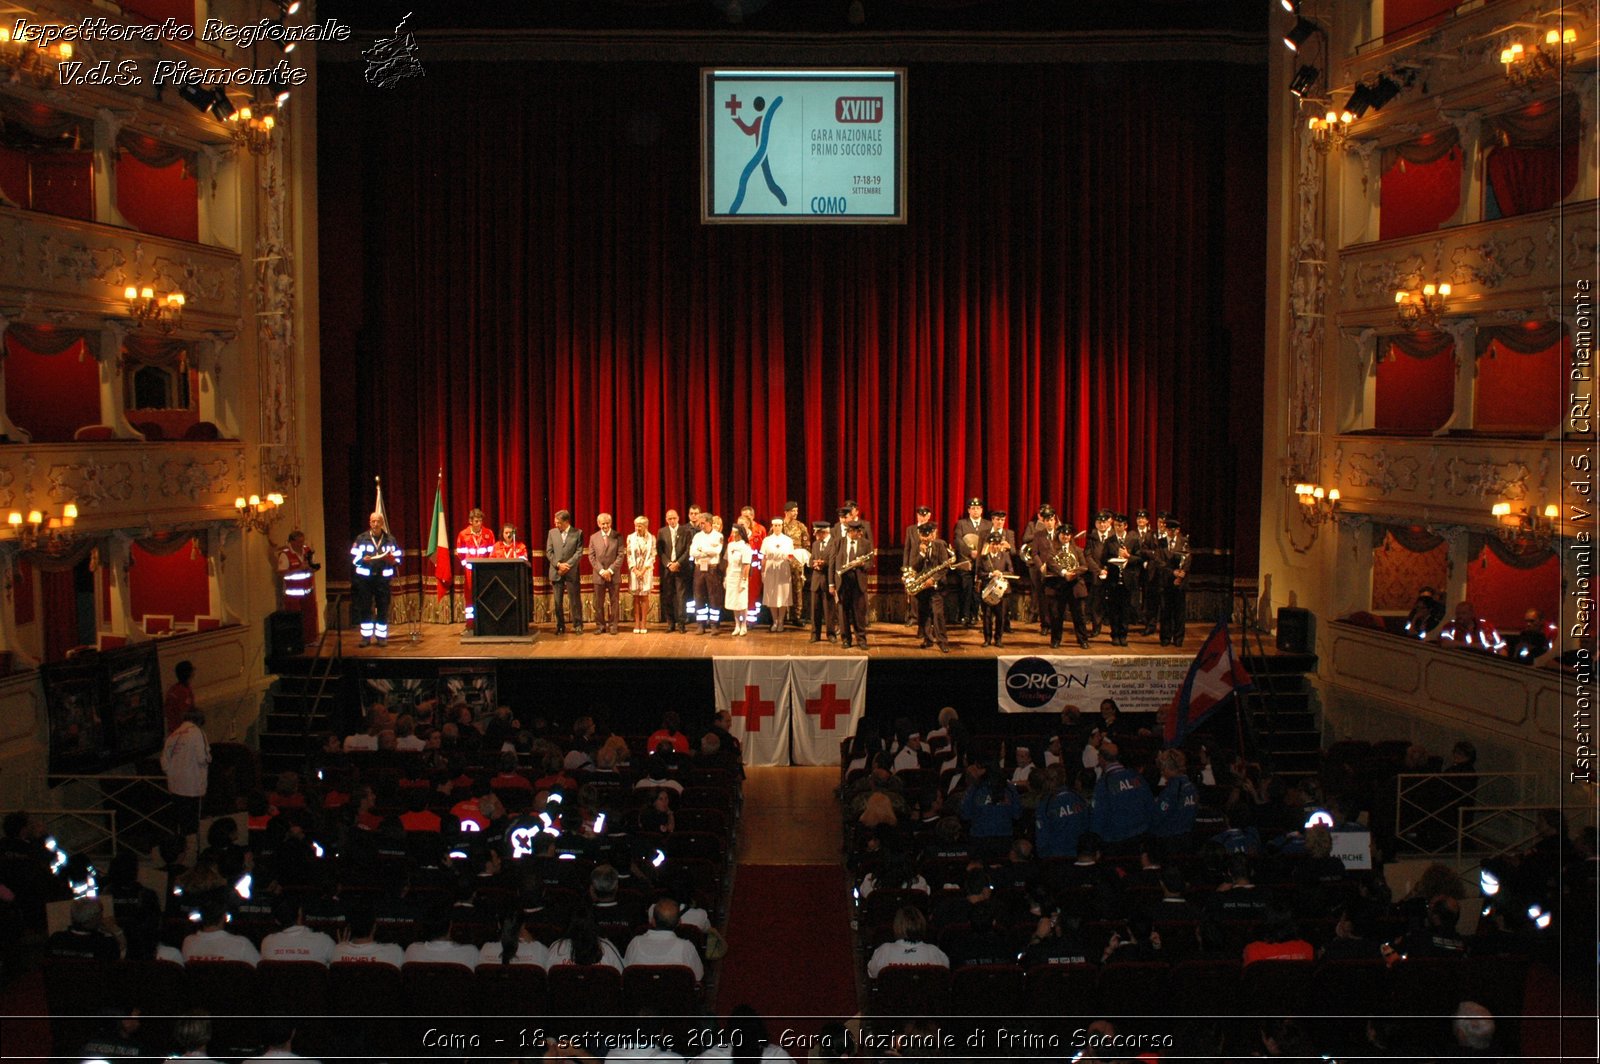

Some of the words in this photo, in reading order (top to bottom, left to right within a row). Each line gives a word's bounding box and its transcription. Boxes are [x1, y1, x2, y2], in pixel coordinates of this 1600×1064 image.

[811, 129, 831, 142] GARA
[836, 129, 882, 142] NAZIONALE
[811, 143, 837, 156] PRIMO
[840, 143, 883, 156] SOCCORSO
[853, 176, 881, 185] 17-18-19
[811, 197, 847, 214] COMO
[1007, 673, 1089, 689] ORION
